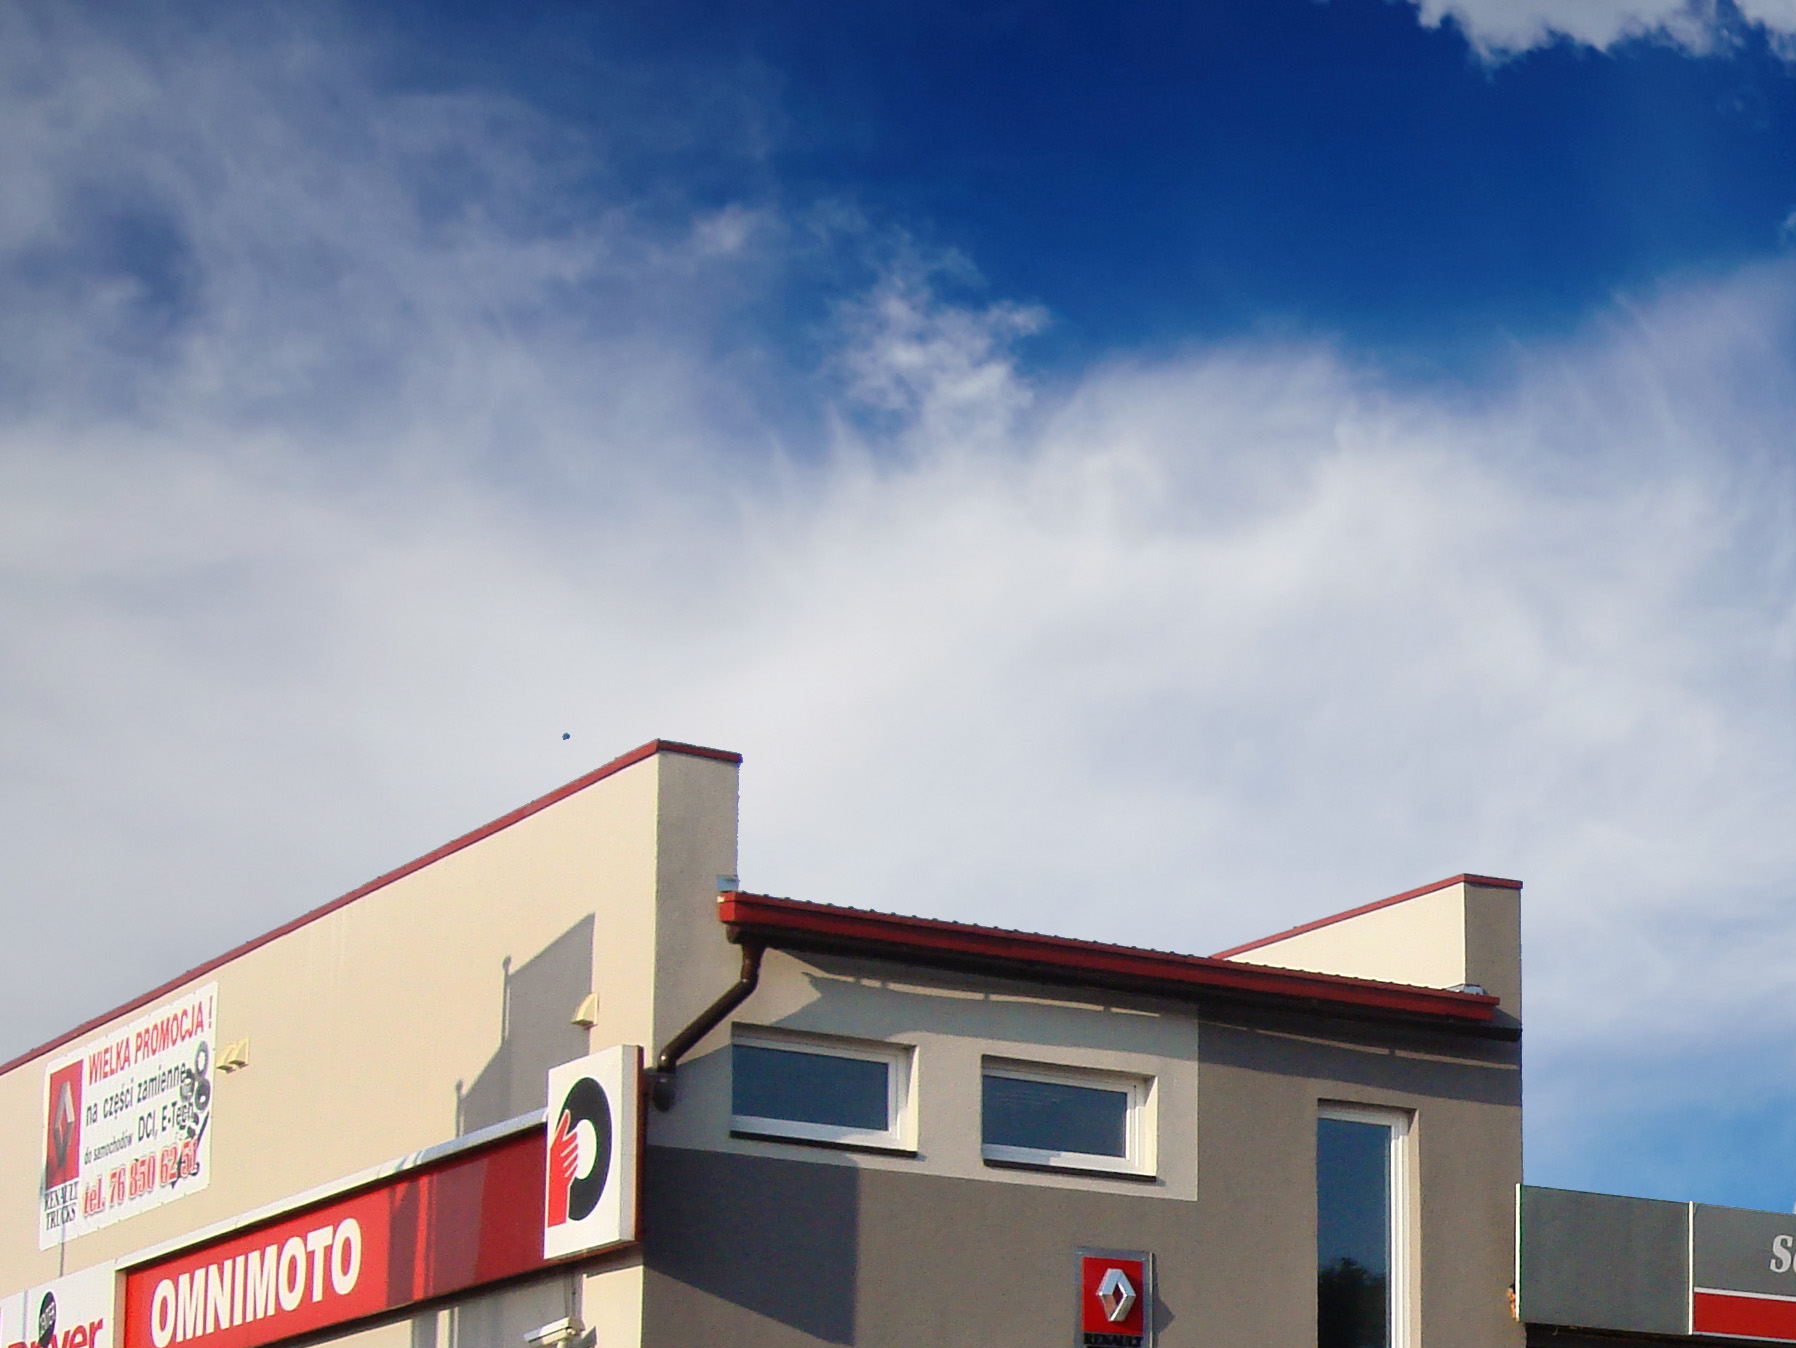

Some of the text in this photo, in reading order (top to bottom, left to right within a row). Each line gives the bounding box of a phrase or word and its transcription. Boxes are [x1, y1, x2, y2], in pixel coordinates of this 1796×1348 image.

[88, 1037, 131, 1085] WIELKA
[134, 1001, 204, 1064] PROMOCJA
[86, 1063, 186, 1126] na części zamienne
[162, 1101, 194, 1131] E-Tech
[83, 1139, 197, 1215] tel. 76 850 62 51
[151, 1218, 361, 1348] OMNIMOTO
